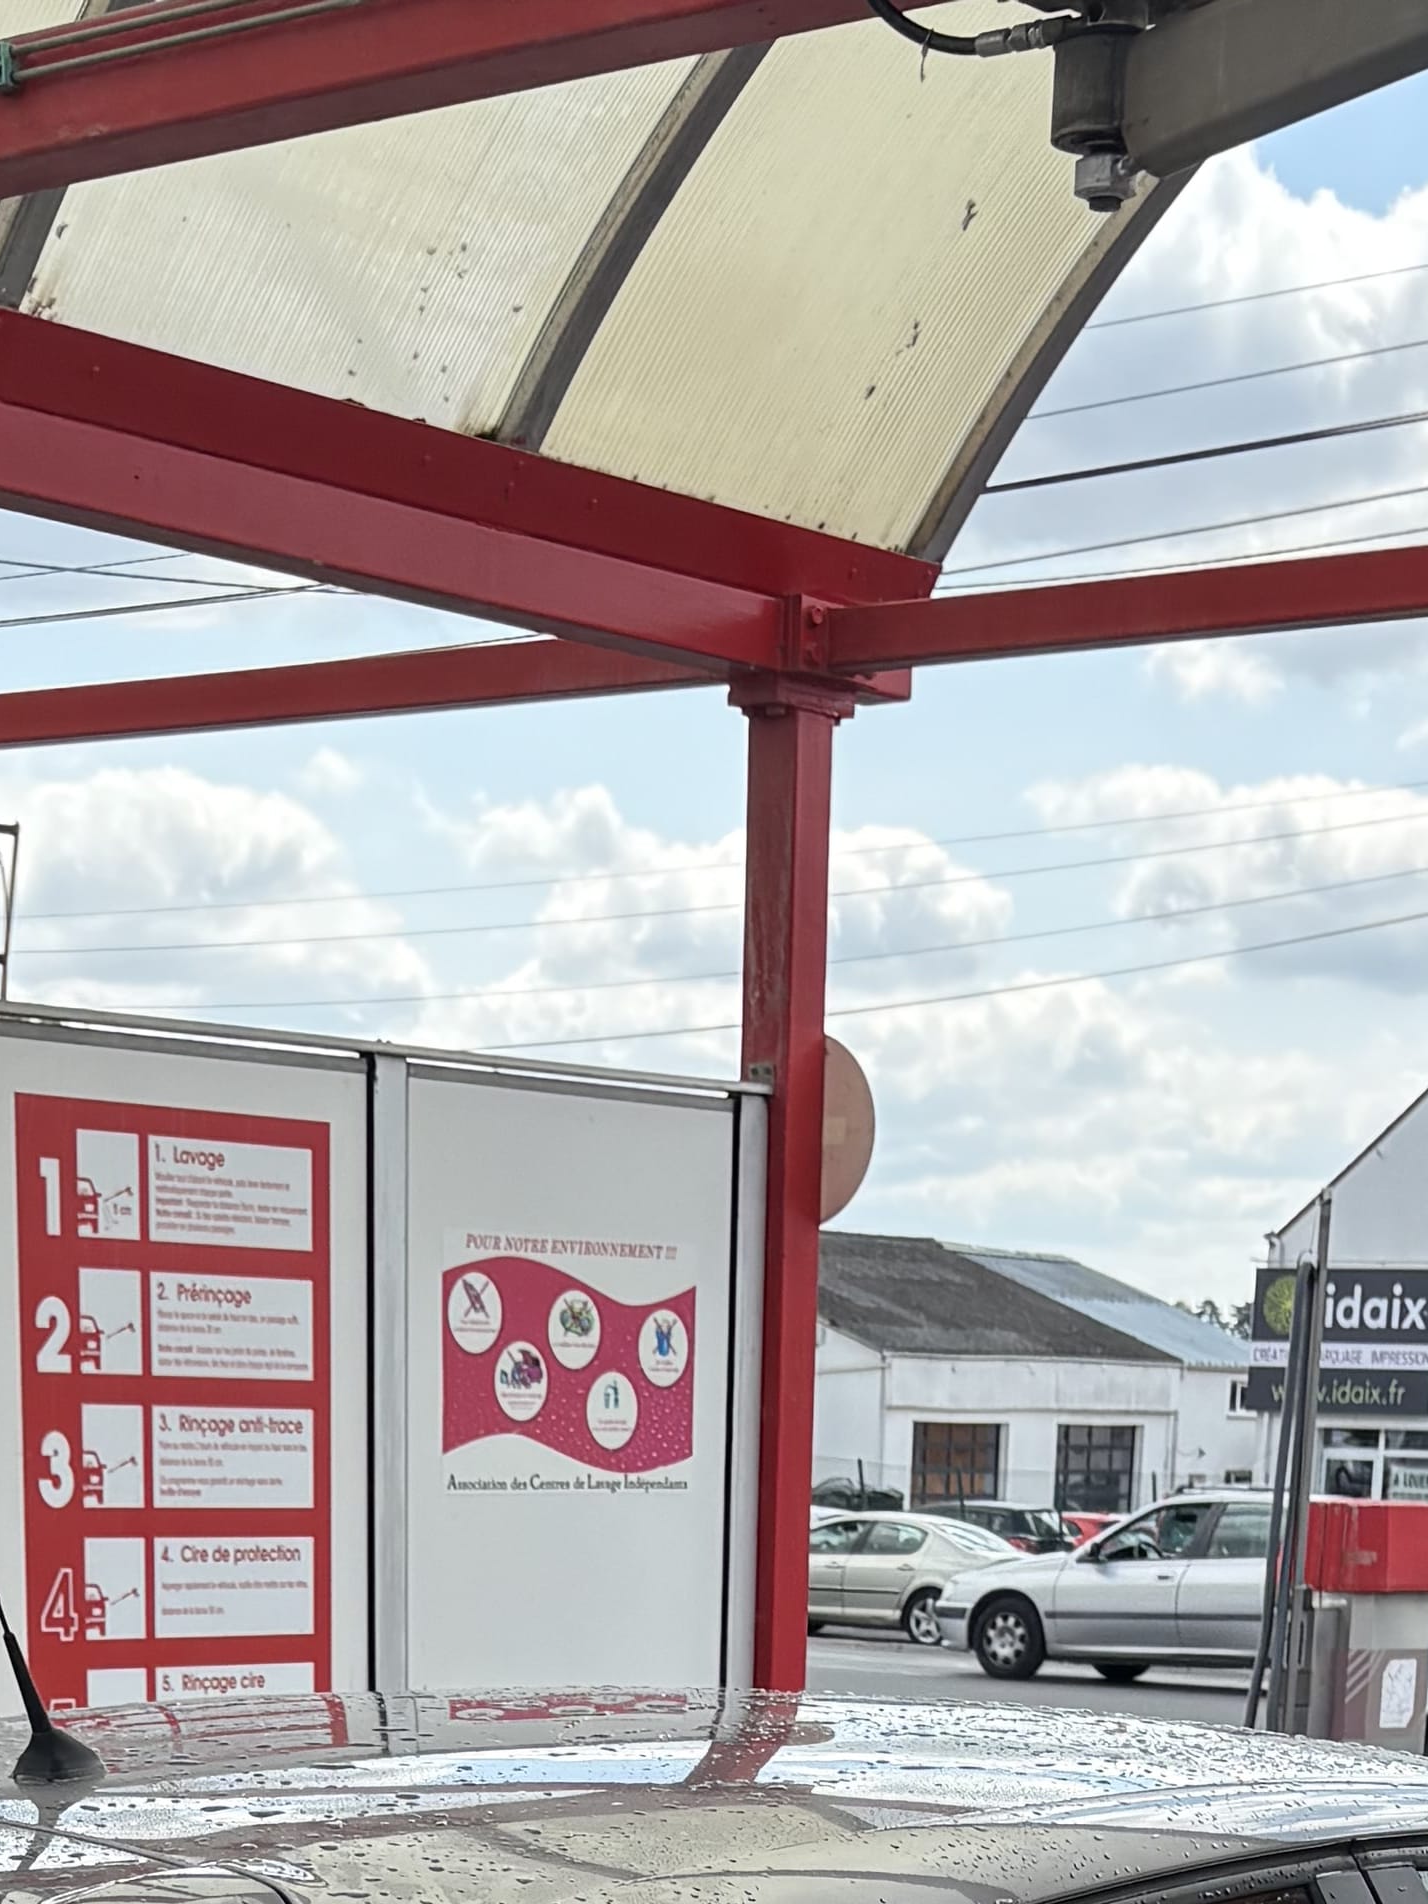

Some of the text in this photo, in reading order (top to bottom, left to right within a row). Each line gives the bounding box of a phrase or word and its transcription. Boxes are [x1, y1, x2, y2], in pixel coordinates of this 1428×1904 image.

[173, 1146, 226, 1171] Lavage
[39, 1157, 62, 1236] 1
[466, 1232, 502, 1251] POUR
[503, 1235, 549, 1254] NOTRE
[551, 1239, 664, 1260] ENVIRONNEMENT
[177, 1282, 253, 1308] Prérinçage
[1324, 1282, 1427, 1330] idaix
[35, 1296, 73, 1374] 2
[179, 1413, 236, 1437] Rinçage
[239, 1415, 304, 1434] anti-trace
[38, 1430, 76, 1509] 3
[447, 1473, 508, 1490] Association
[510, 1476, 528, 1490] des
[530, 1473, 571, 1490] Centres
[573, 1476, 585, 1490] de
[587, 1473, 622, 1494] Lavage
[181, 1544, 209, 1563] Cire
[212, 1545, 231, 1563] de
[233, 1544, 302, 1566] protection
[41, 1567, 79, 1642] 4
[182, 1673, 237, 1694] Rinçage
[240, 1671, 266, 1689] cire
